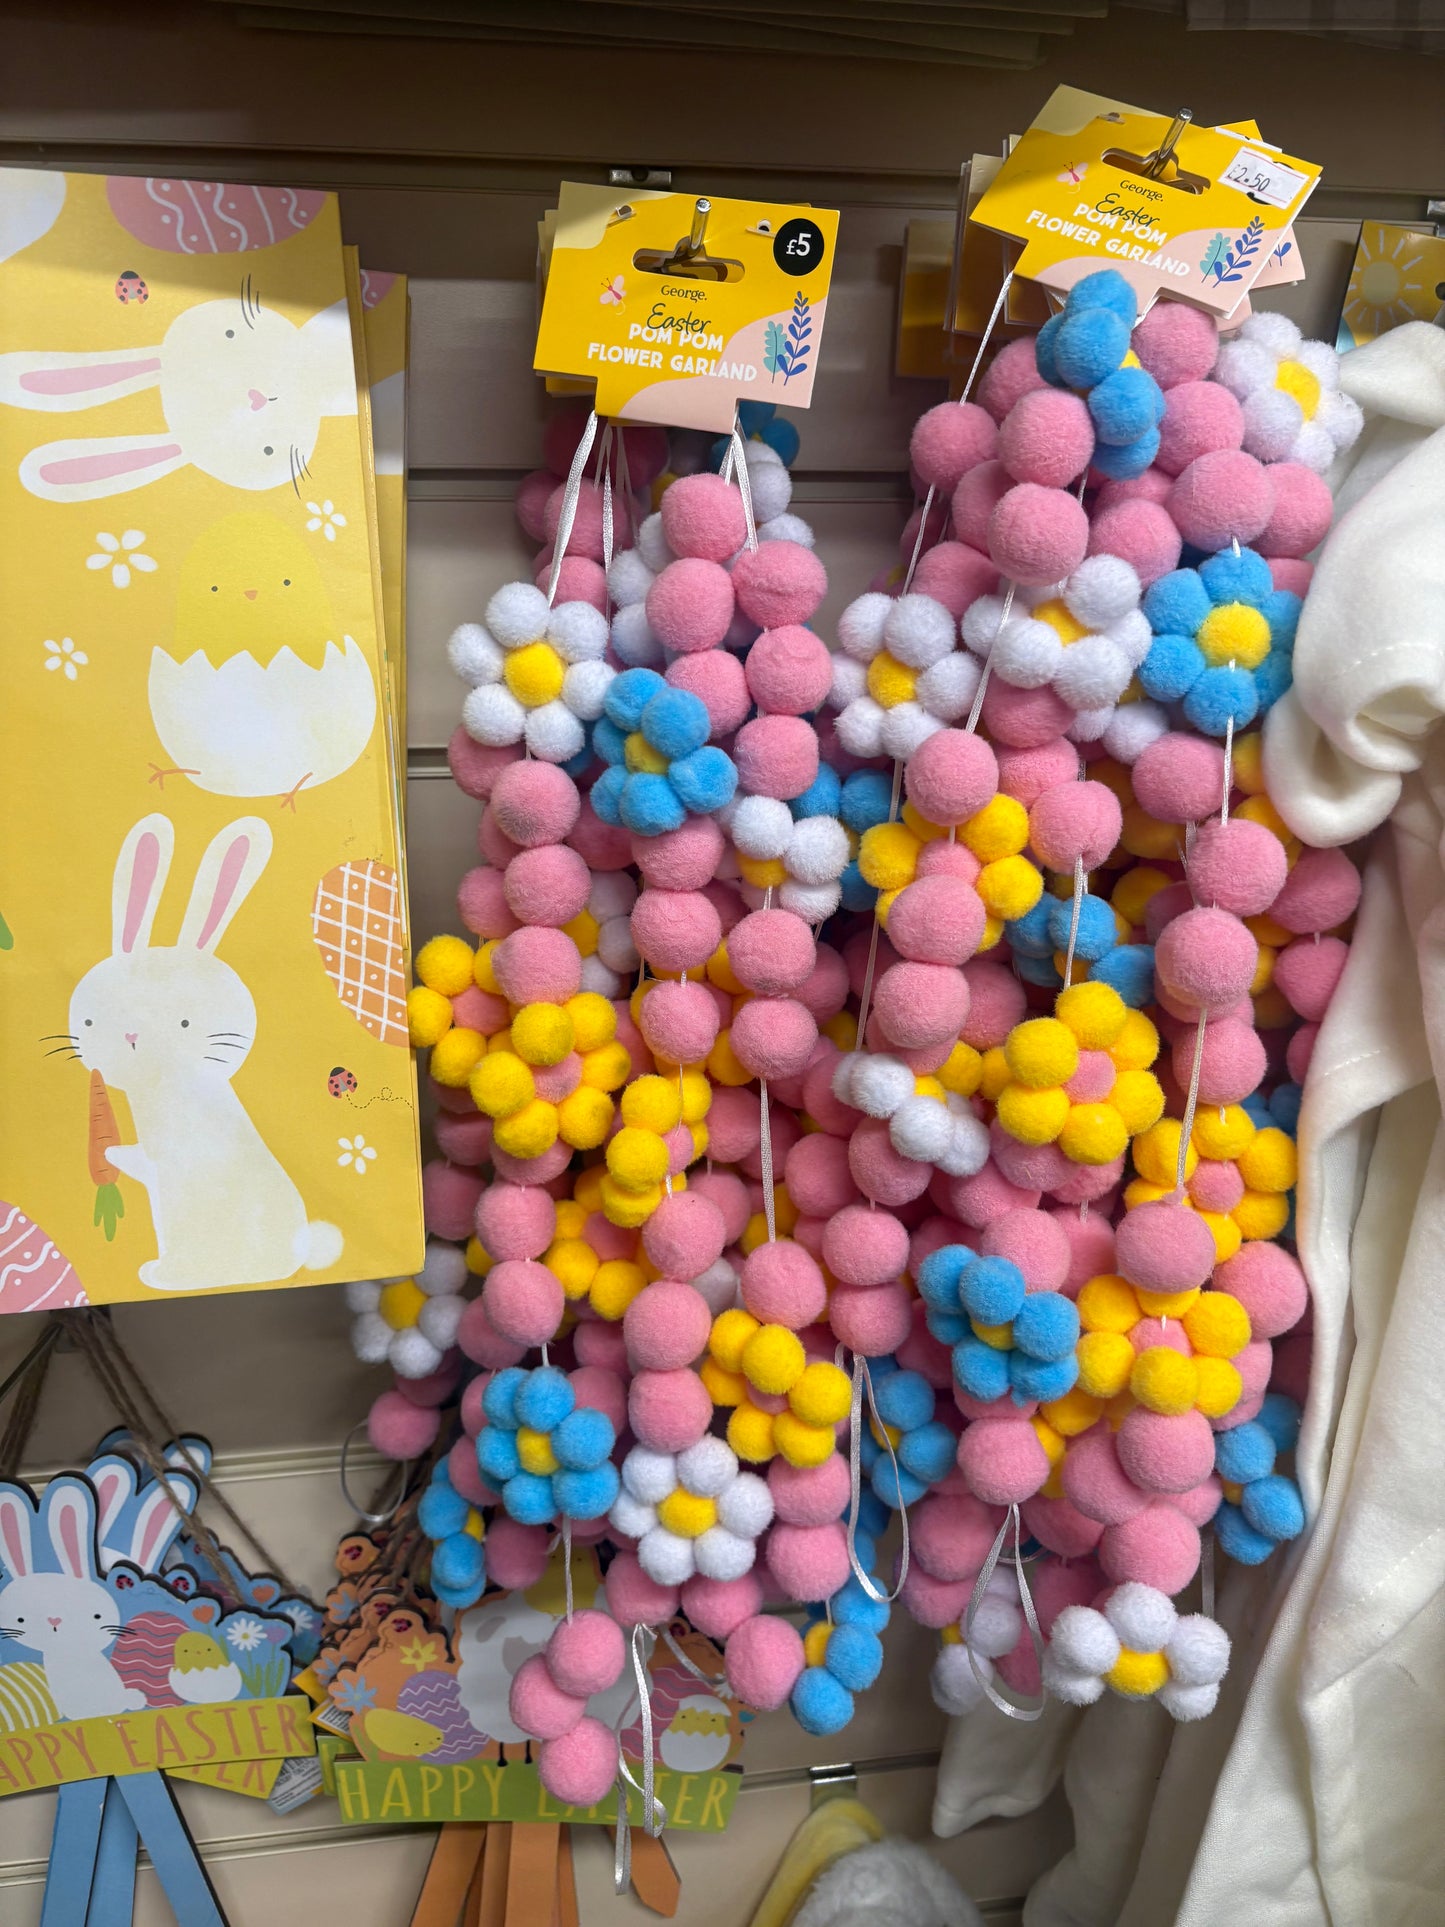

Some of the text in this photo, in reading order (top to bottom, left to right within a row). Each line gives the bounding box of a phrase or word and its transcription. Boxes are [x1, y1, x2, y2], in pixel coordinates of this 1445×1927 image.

[1227, 164, 1271, 192] £2.50
[1073, 203, 1168, 247] POM POM
[1095, 193, 1160, 228] Easter
[786, 232, 812, 257] £5
[1026, 209, 1191, 277] FLOWER GARLAND
[646, 302, 712, 335] Easter
[628, 323, 723, 352] POM POM
[587, 342, 758, 382] FLOWER GARLAND
[114, 1703, 310, 1769] EASTER
[337, 1764, 508, 1821] HAPPY
